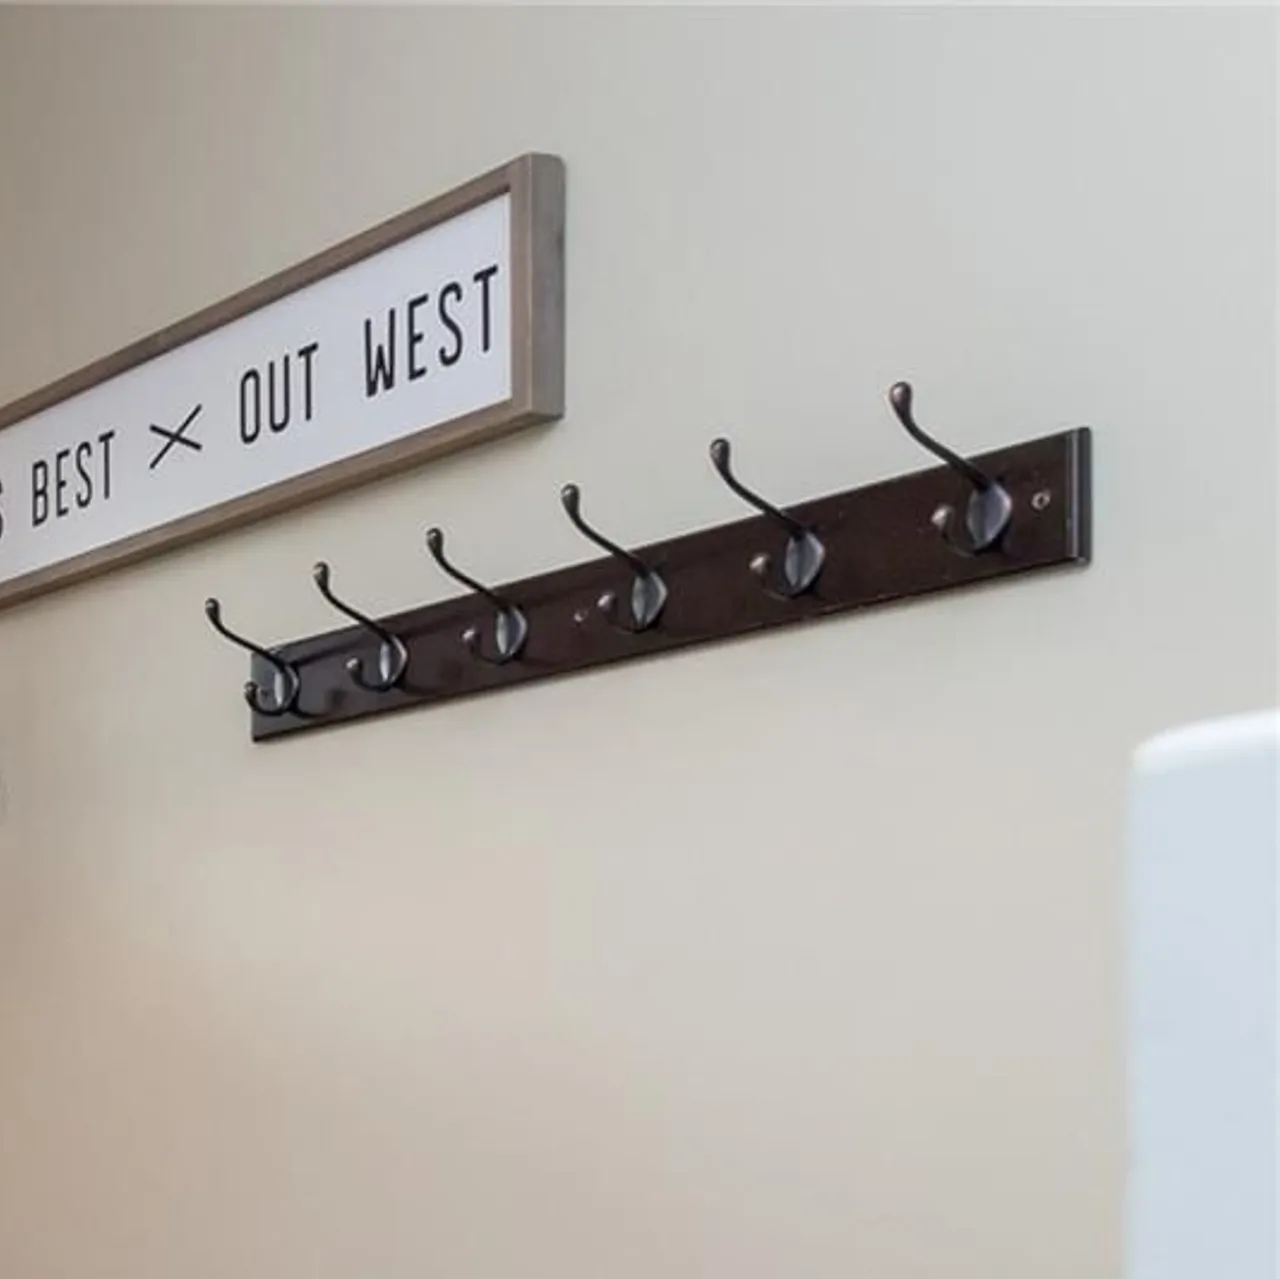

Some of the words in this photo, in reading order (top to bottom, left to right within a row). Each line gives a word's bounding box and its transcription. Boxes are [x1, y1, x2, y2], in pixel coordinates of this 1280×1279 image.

[32, 429, 116, 528] BEST
[240, 342, 319, 445] OUT
[364, 264, 499, 398] WEST
